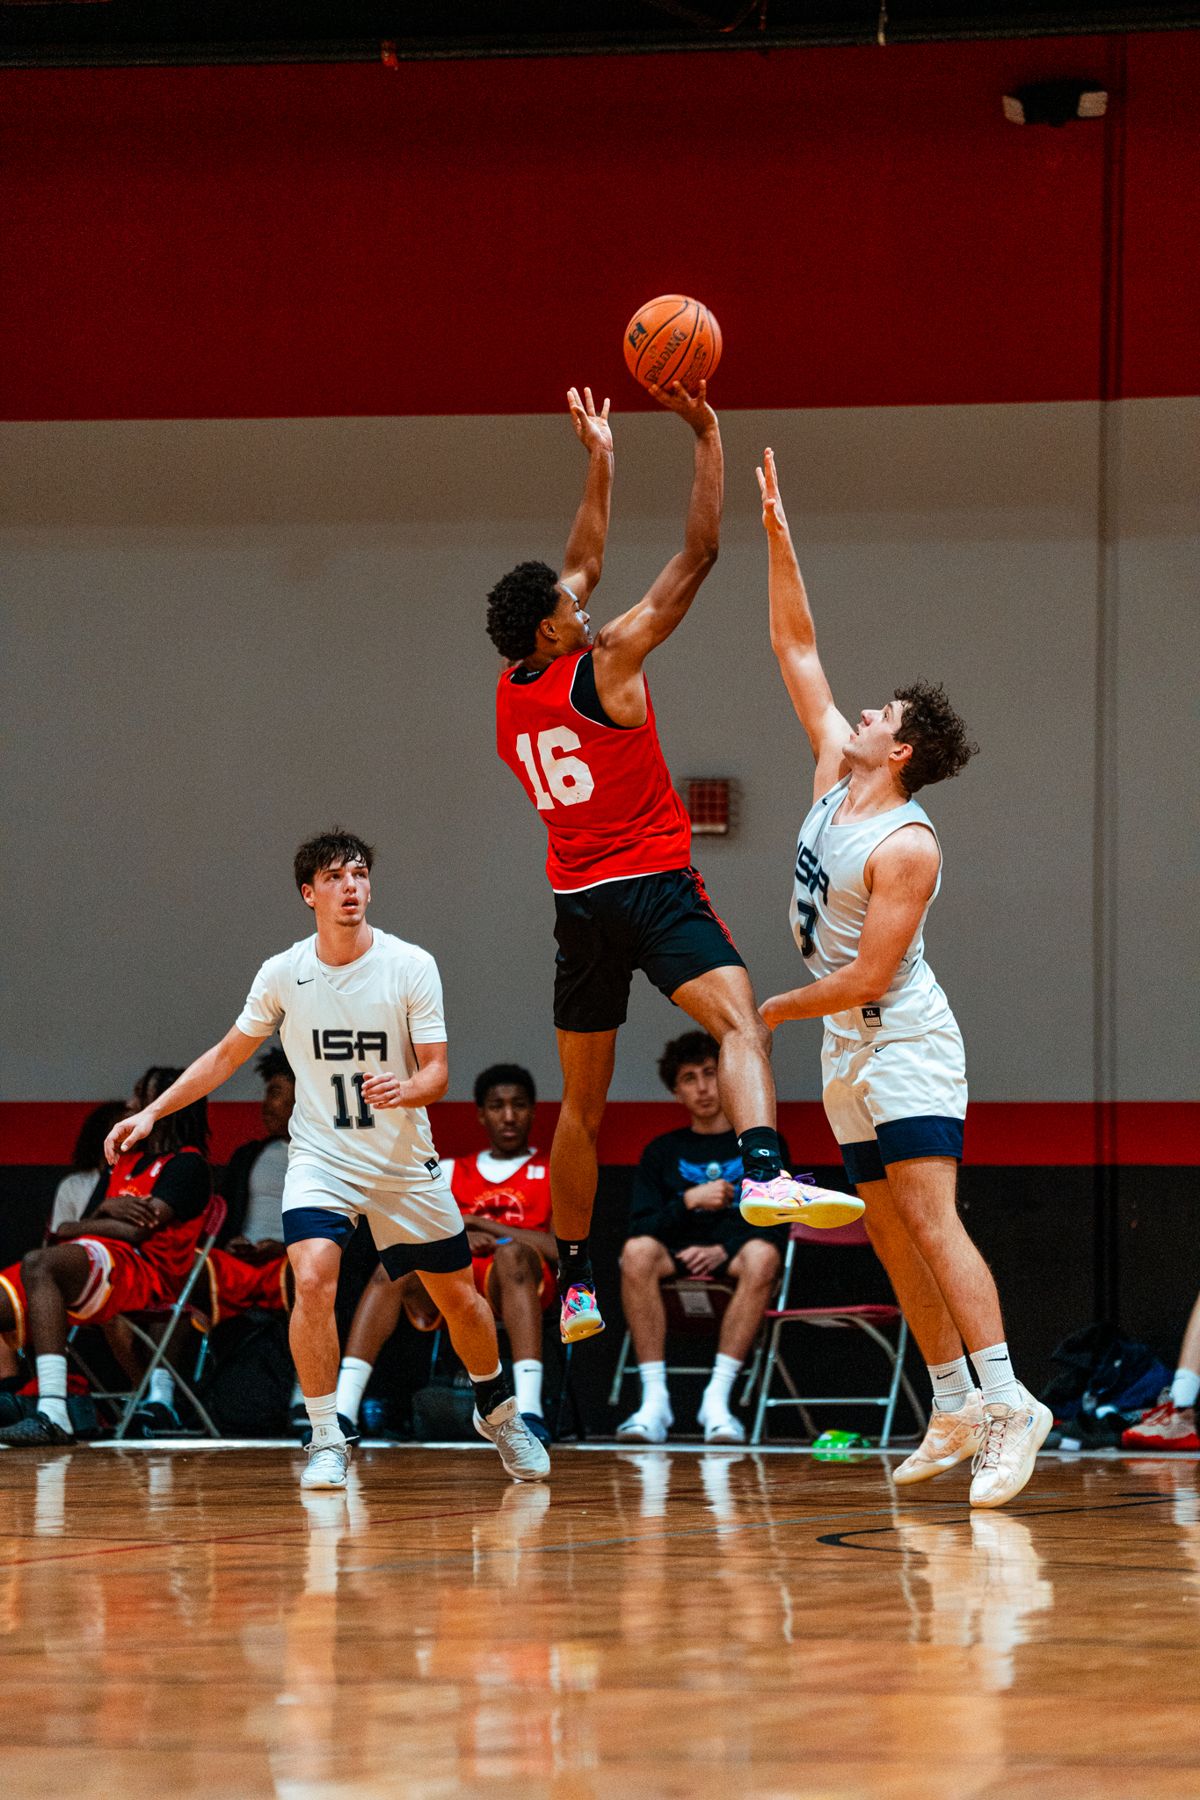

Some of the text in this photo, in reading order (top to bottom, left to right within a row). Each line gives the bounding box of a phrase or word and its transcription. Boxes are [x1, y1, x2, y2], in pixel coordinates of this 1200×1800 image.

[516, 725, 595, 810] 16
[312, 1029, 388, 1062] ISA
[330, 1072, 376, 1130] 11
